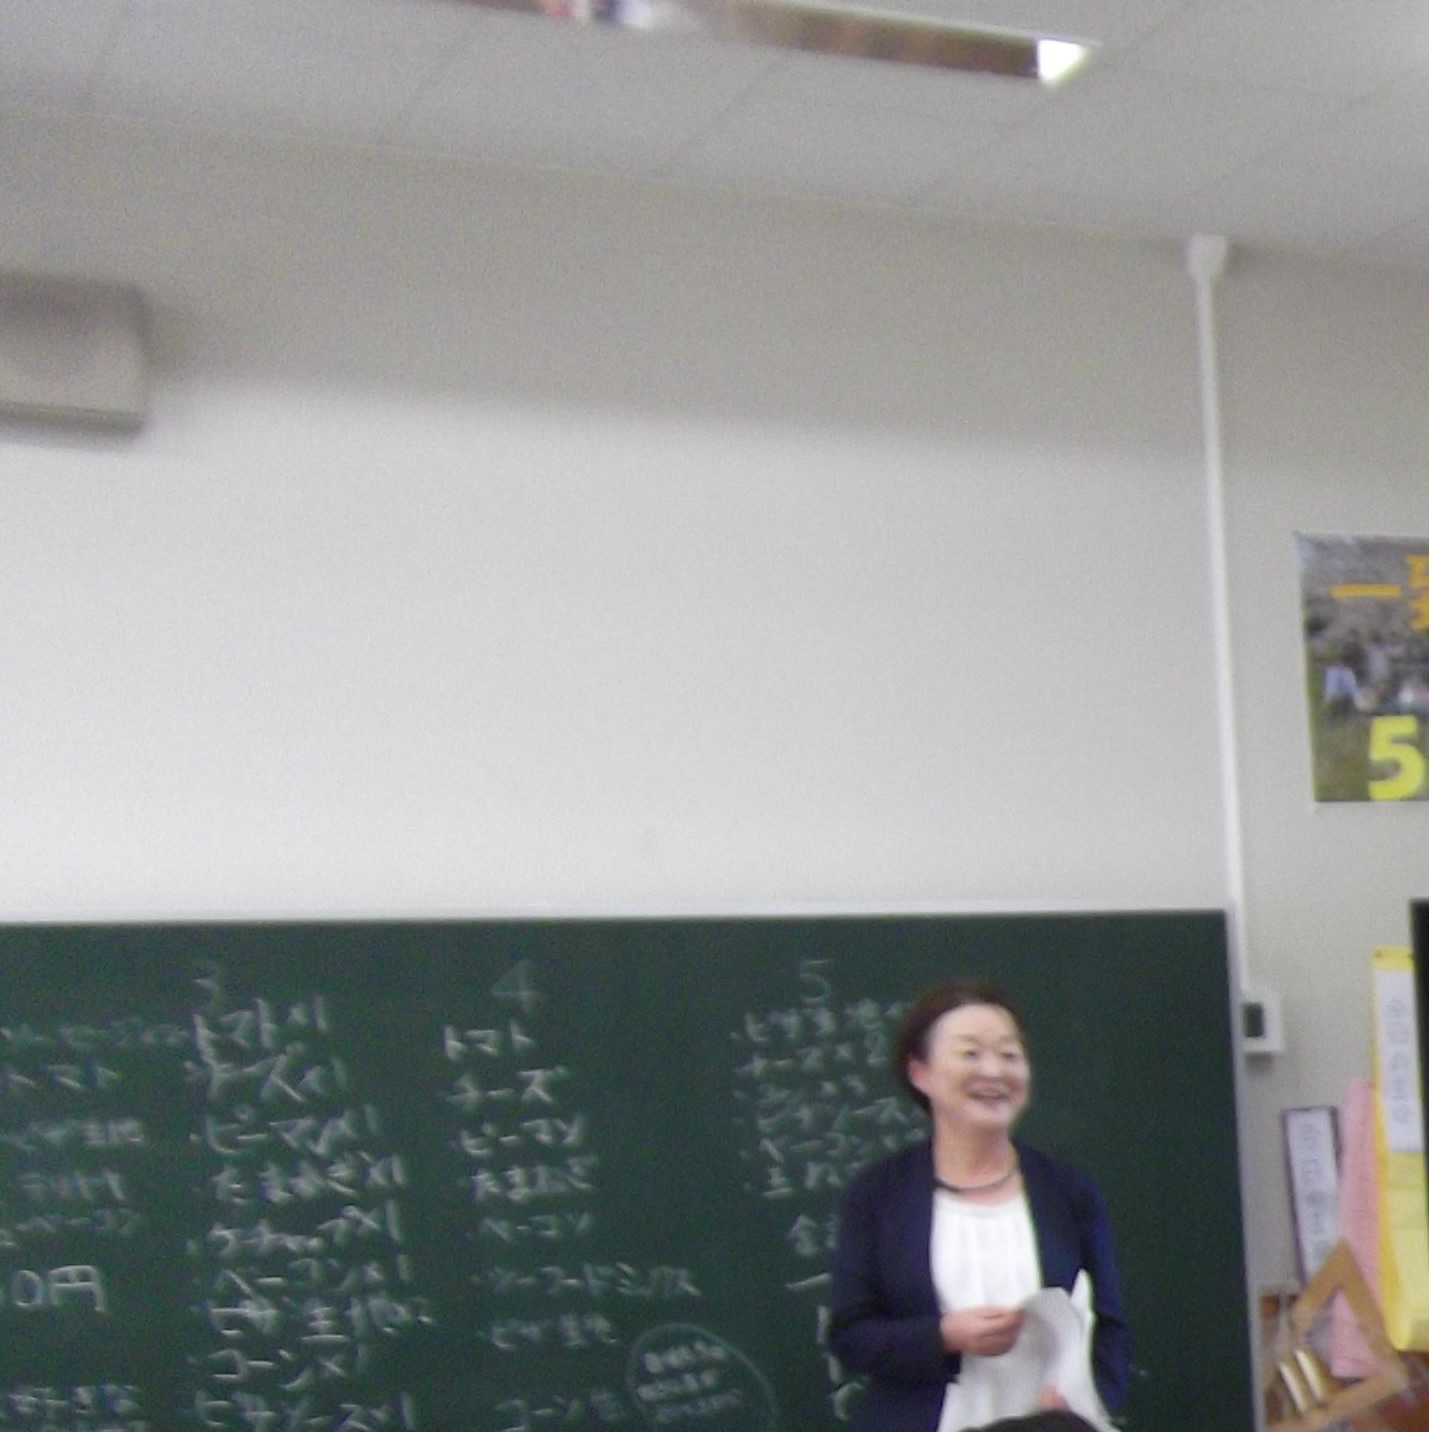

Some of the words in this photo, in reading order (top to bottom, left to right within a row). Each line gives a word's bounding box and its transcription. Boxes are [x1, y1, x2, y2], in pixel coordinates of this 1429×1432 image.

[491, 958, 544, 1012] 4
[801, 958, 834, 1003] 5
[443, 1019, 535, 1061] トマト
[0, 1265, 108, 1313] 0円
